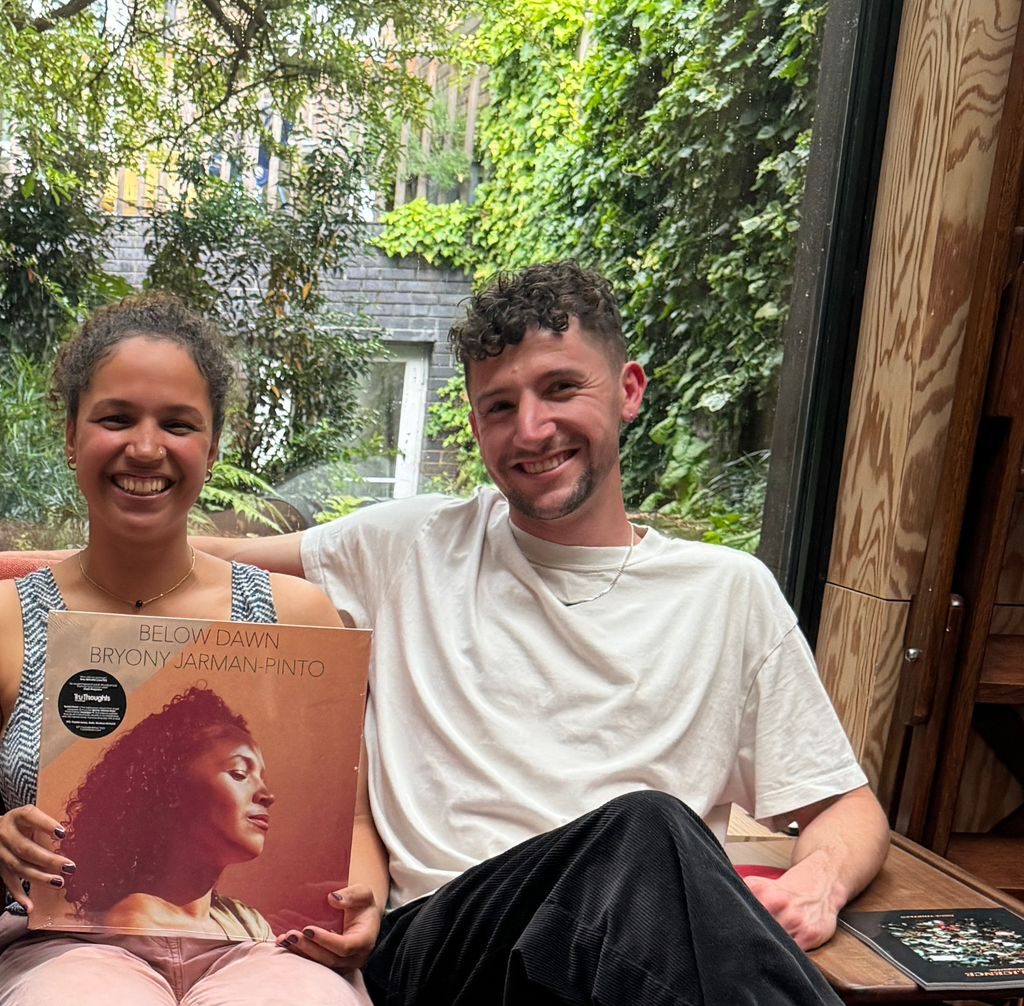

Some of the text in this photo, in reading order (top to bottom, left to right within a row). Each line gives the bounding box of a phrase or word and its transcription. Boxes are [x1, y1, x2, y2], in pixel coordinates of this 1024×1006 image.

[139, 624, 280, 649] BELOW DAWN
[90, 646, 325, 678] BRYONY JARMAN-PINTO
